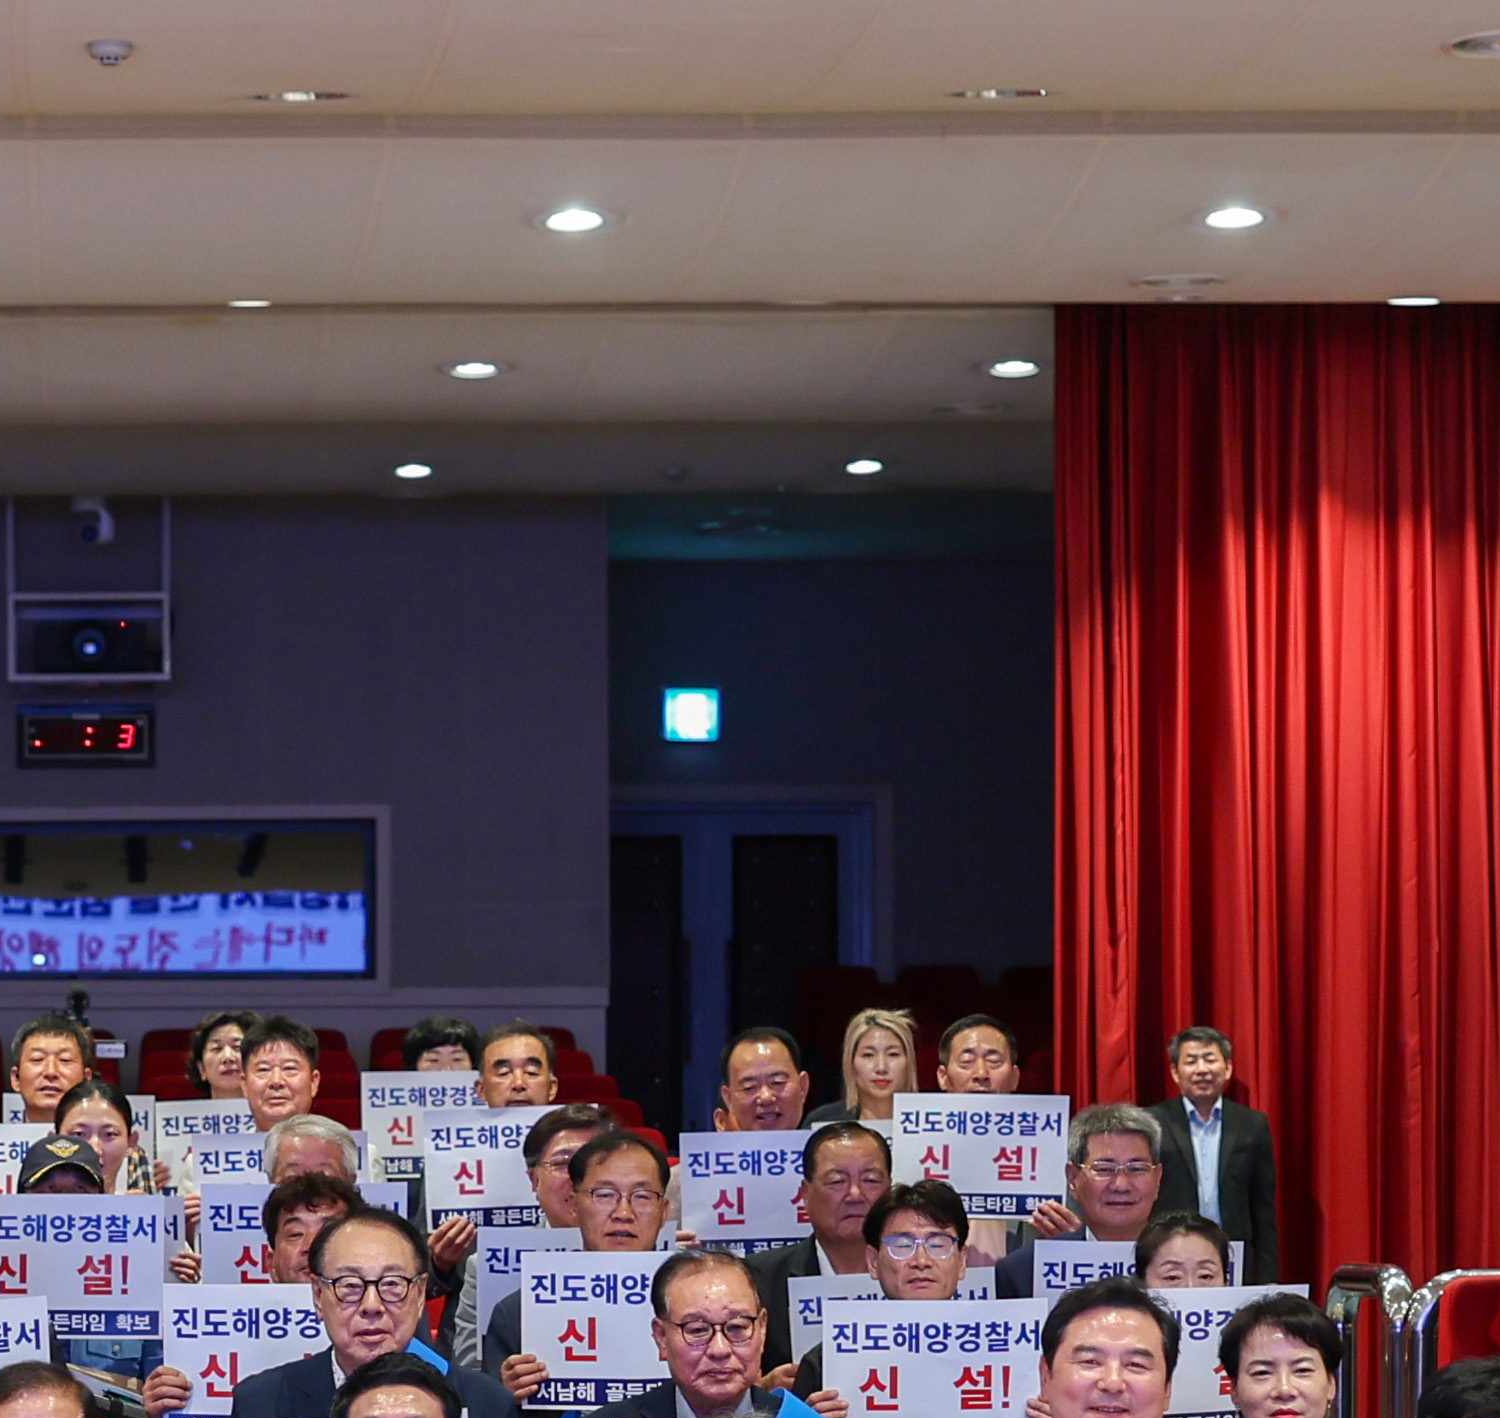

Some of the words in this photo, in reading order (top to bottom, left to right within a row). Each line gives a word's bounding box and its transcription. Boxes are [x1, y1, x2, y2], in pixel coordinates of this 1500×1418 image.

[900, 1110, 1062, 1137] 진도해양경찰서
[919, 1144, 950, 1179] 신
[992, 1145, 1037, 1181] 설!
[76, 1254, 129, 1296] 설!
[832, 1319, 1040, 1354] 진도해양경찰서
[199, 1351, 244, 1404] 신
[536, 1381, 596, 1403] 서남해
[859, 1365, 899, 1411] 신
[953, 1364, 1011, 1410] 설!
